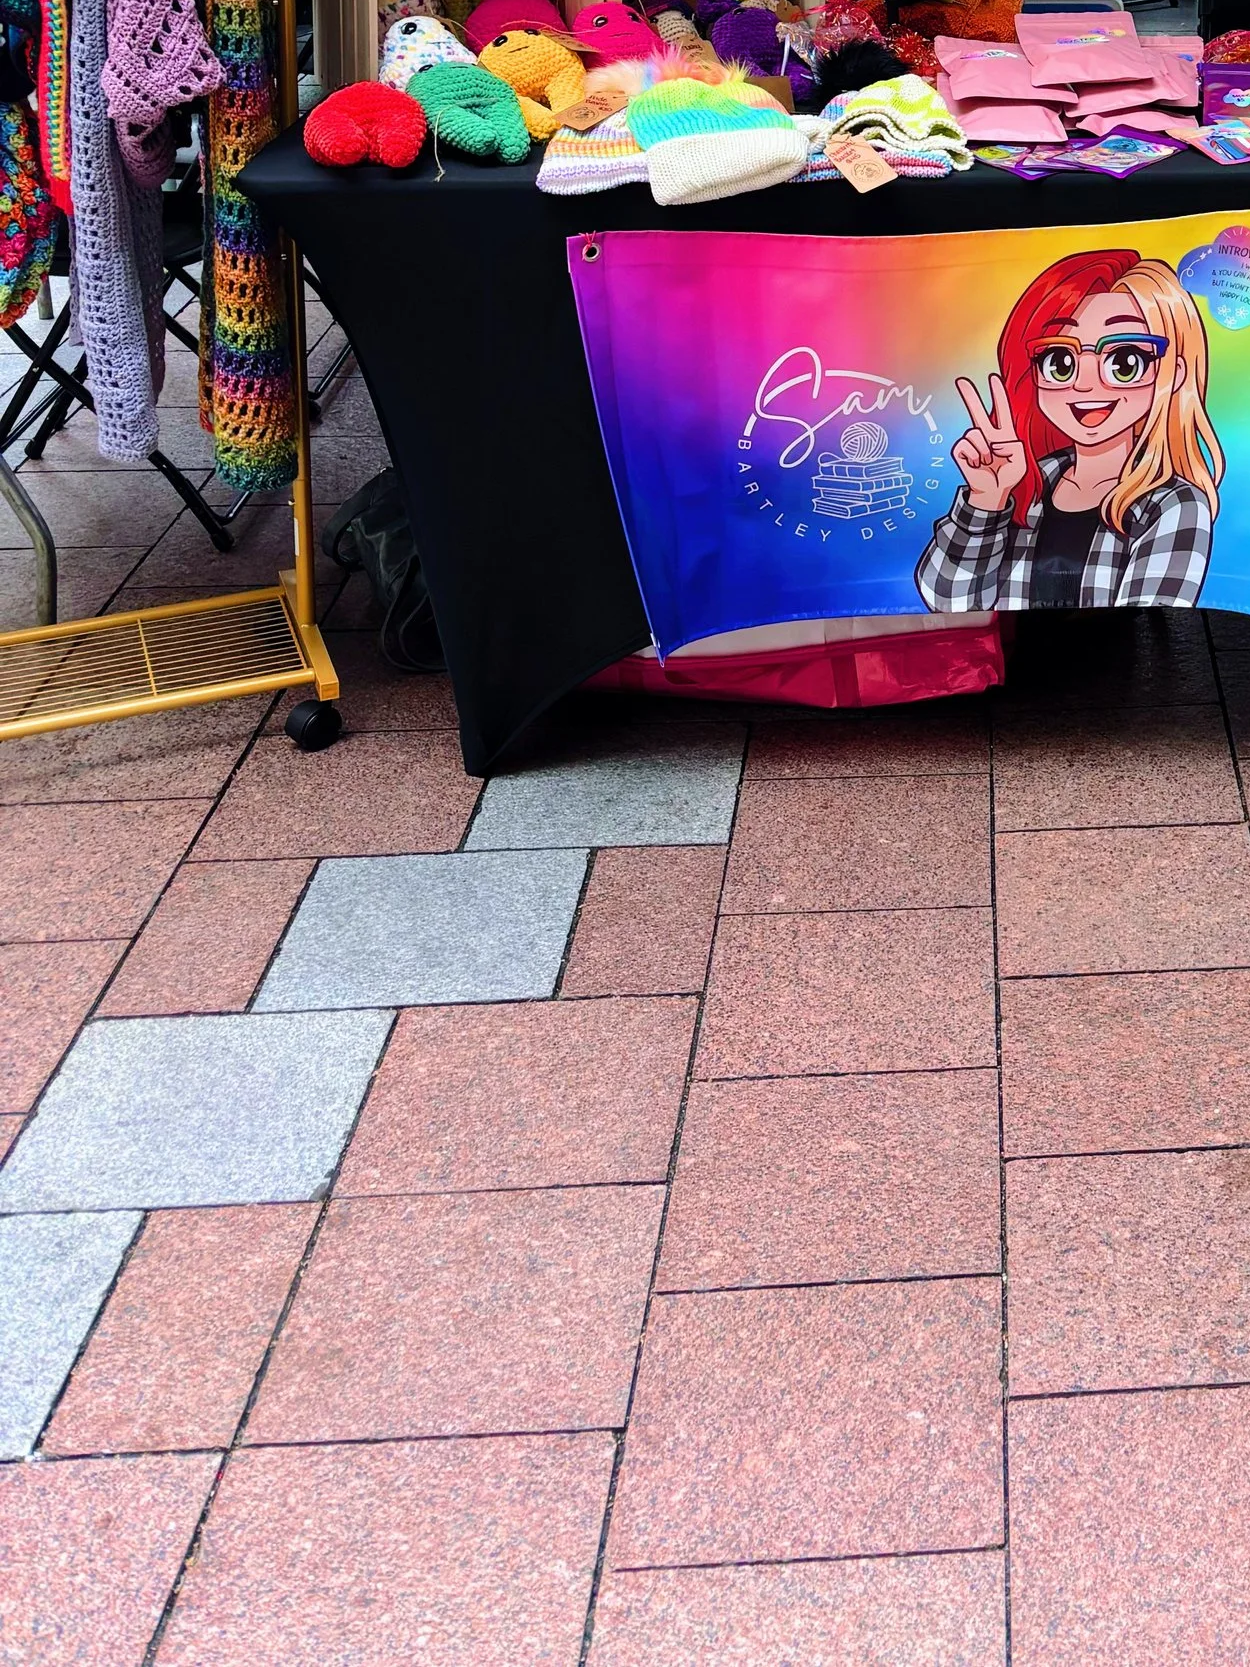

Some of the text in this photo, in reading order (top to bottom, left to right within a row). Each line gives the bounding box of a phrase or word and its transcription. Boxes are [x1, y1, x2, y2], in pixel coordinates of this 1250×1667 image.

[1233, 270, 1247, 279] CAN
[1211, 279, 1225, 287] BUT
[1229, 282, 1249, 294] WON'T
[1219, 291, 1239, 300] HAPPY
[755, 346, 932, 468] Sam
[737, 433, 945, 542] BARTLEY DESIGNS
